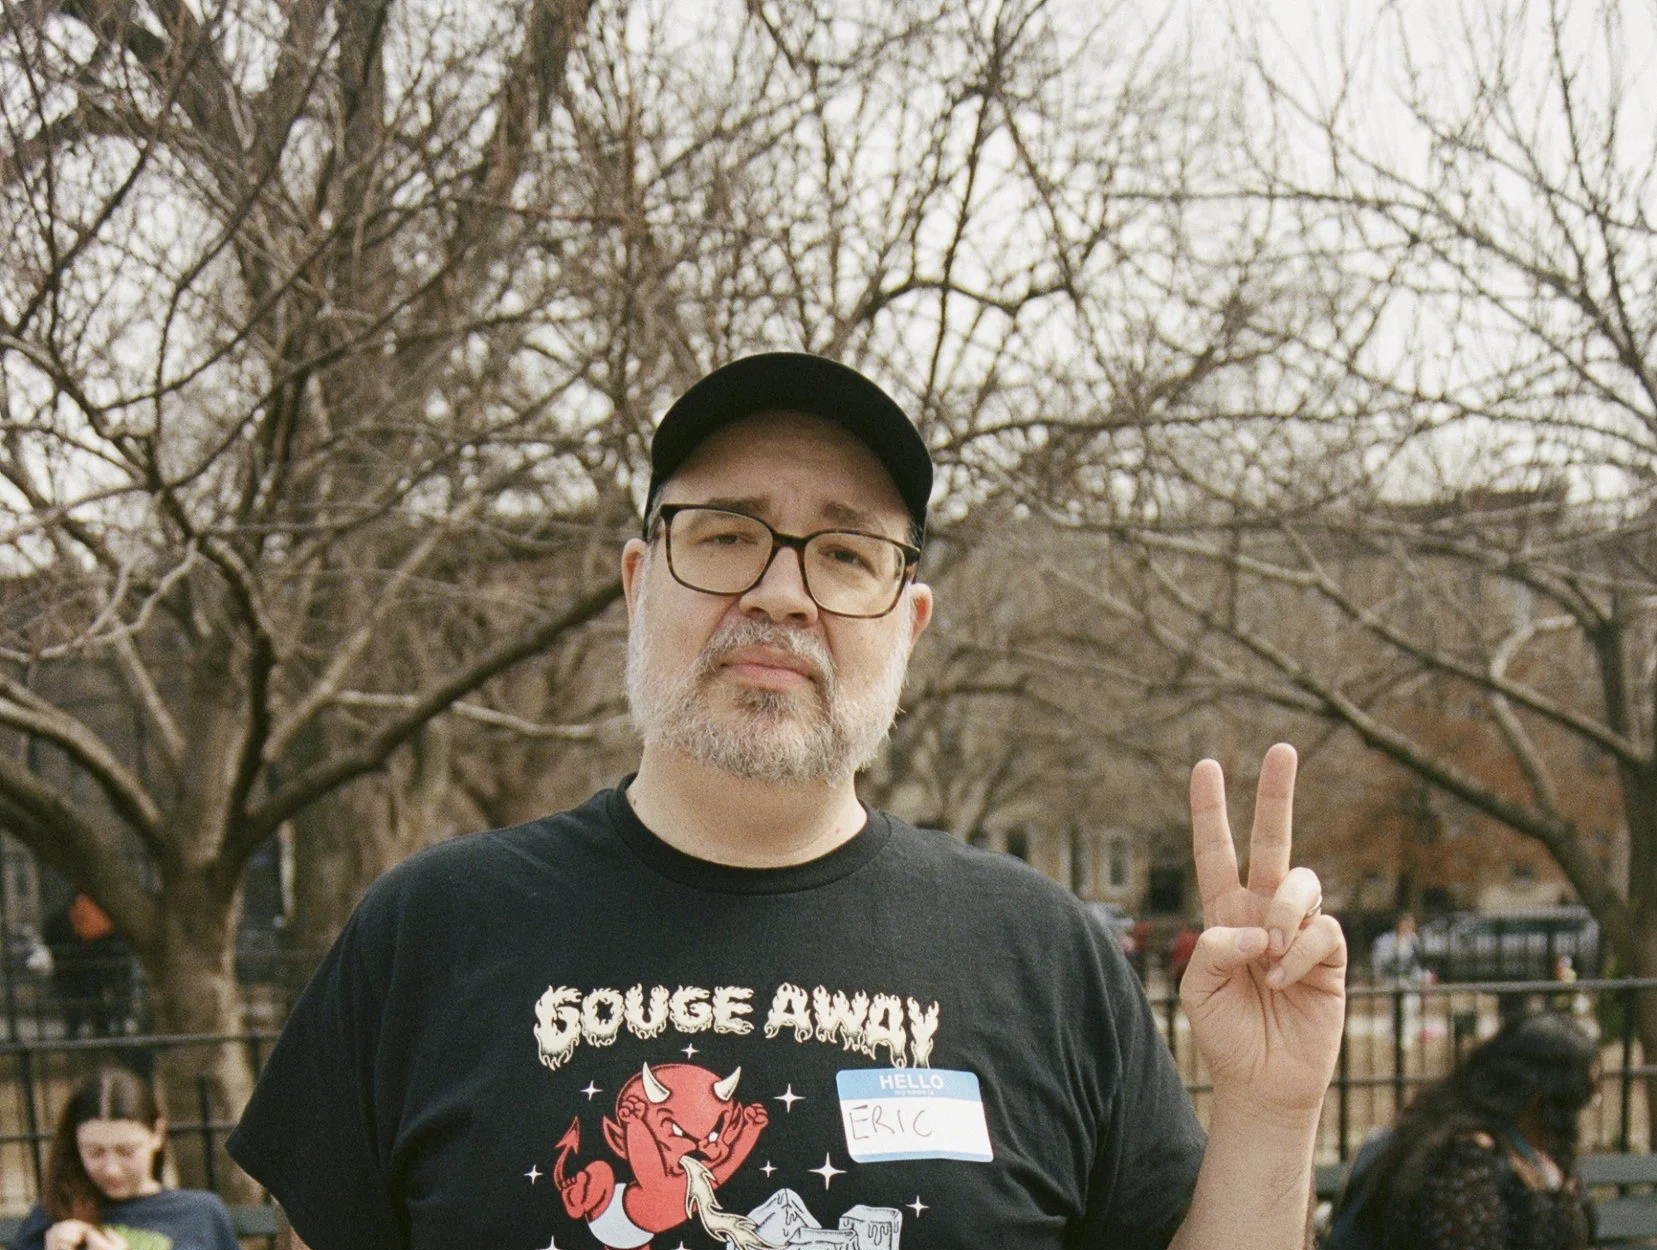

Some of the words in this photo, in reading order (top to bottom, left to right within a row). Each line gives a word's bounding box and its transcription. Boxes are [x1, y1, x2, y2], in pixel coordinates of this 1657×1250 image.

[533, 983, 755, 1071] GOUGE
[764, 982, 940, 1070] AWAY
[879, 1075, 944, 1090] HELLO
[849, 1104, 933, 1140] ERIC
